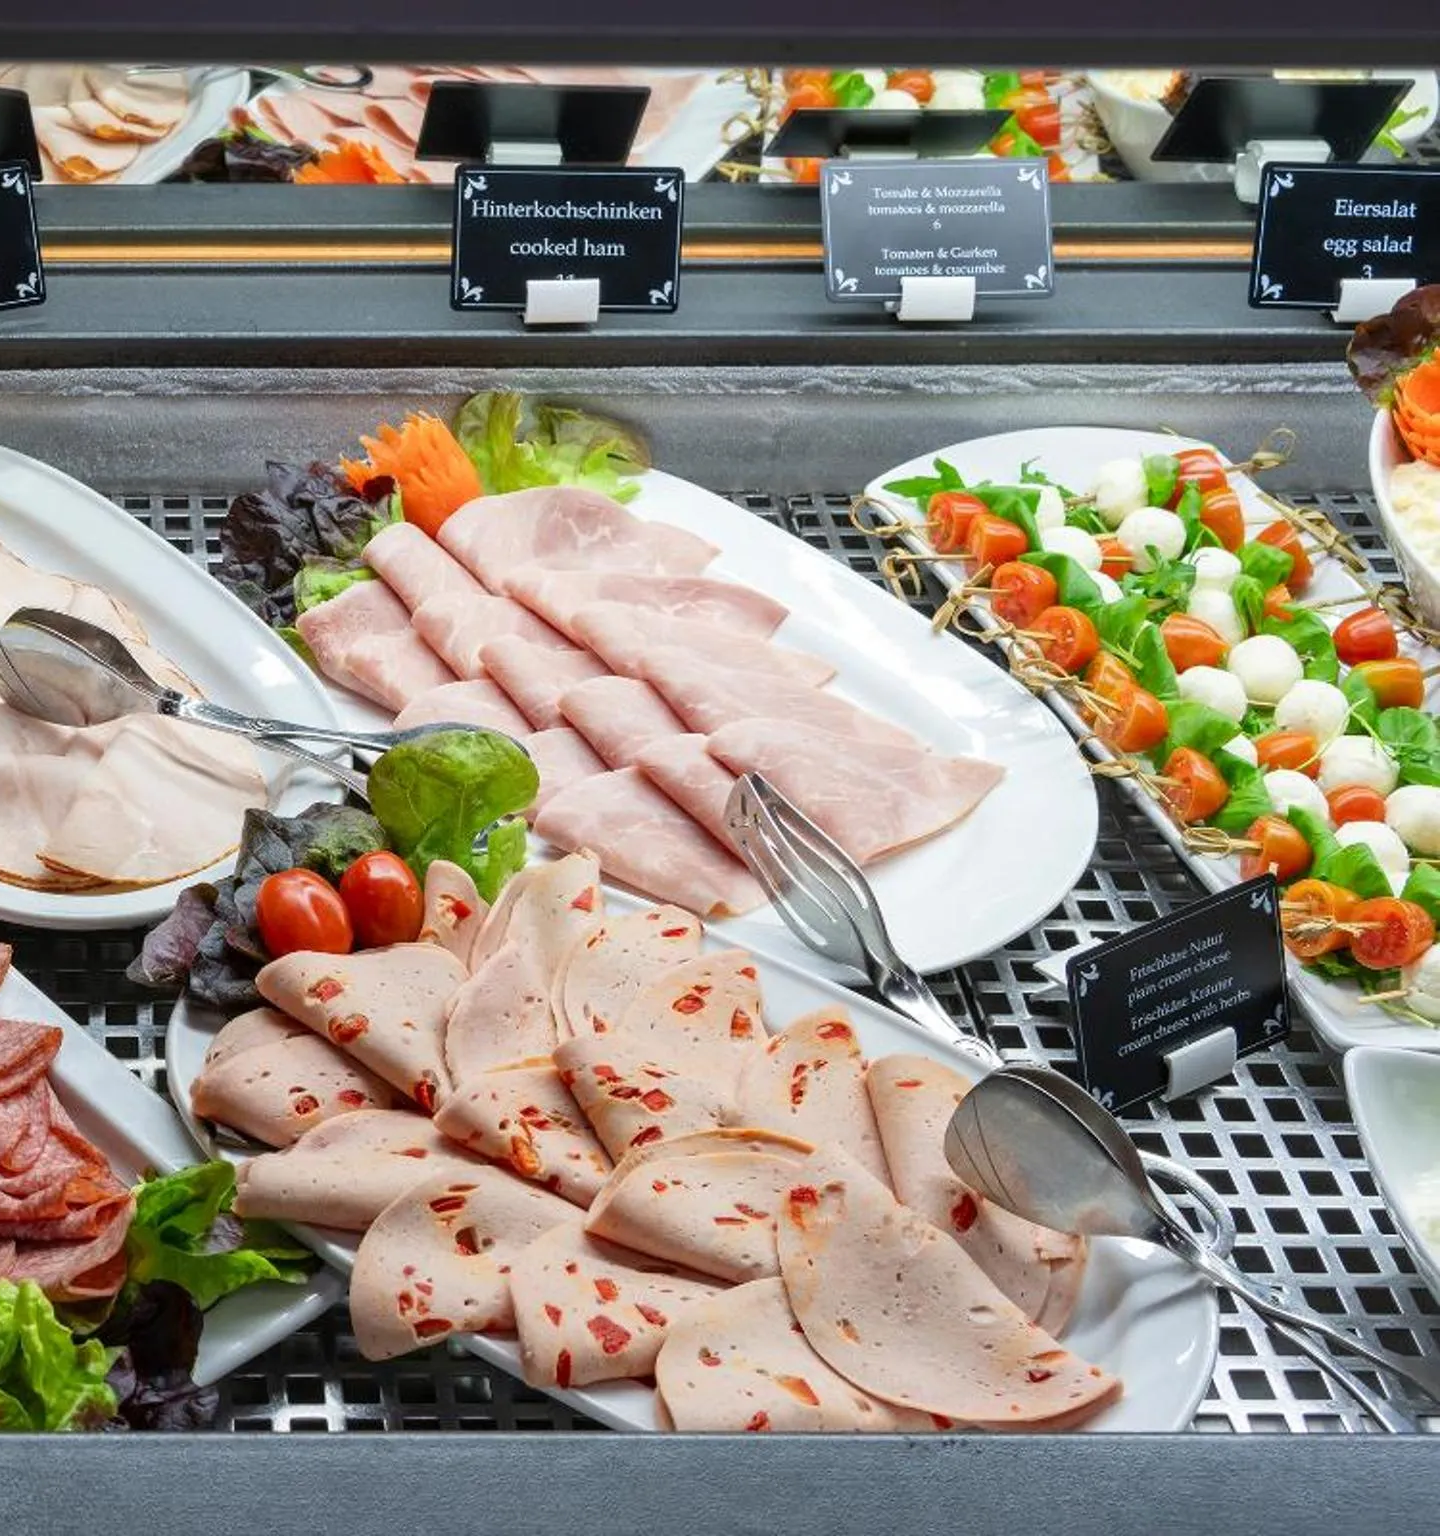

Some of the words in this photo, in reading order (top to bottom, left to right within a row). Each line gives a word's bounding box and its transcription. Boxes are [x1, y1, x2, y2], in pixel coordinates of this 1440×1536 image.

[872, 187, 919, 199] Tomate
[921, 187, 932, 198] &
[935, 186, 1002, 198] Mozzarella
[471, 200, 662, 219] Hinterkochschinken
[868, 204, 922, 215] tomatoes
[924, 203, 936, 214] &
[939, 201, 1006, 213] mozzarella
[1334, 199, 1417, 218] Eiersalat
[932, 218, 941, 230] 6
[510, 238, 577, 256] cooked
[583, 238, 625, 256] ham
[937, 248, 949, 259] &
[950, 247, 998, 258] Gurken
[1323, 238, 1358, 257] egg
[1362, 235, 1412, 253] salad
[875, 266, 929, 276] tomatoes
[931, 264, 944, 275] &
[945, 262, 1007, 275] cucumber
[1189, 932, 1224, 956] Natur
[1153, 1017, 1190, 1040] cheese
[1192, 1001, 1218, 1021] with
[1220, 989, 1251, 1010] herbs
